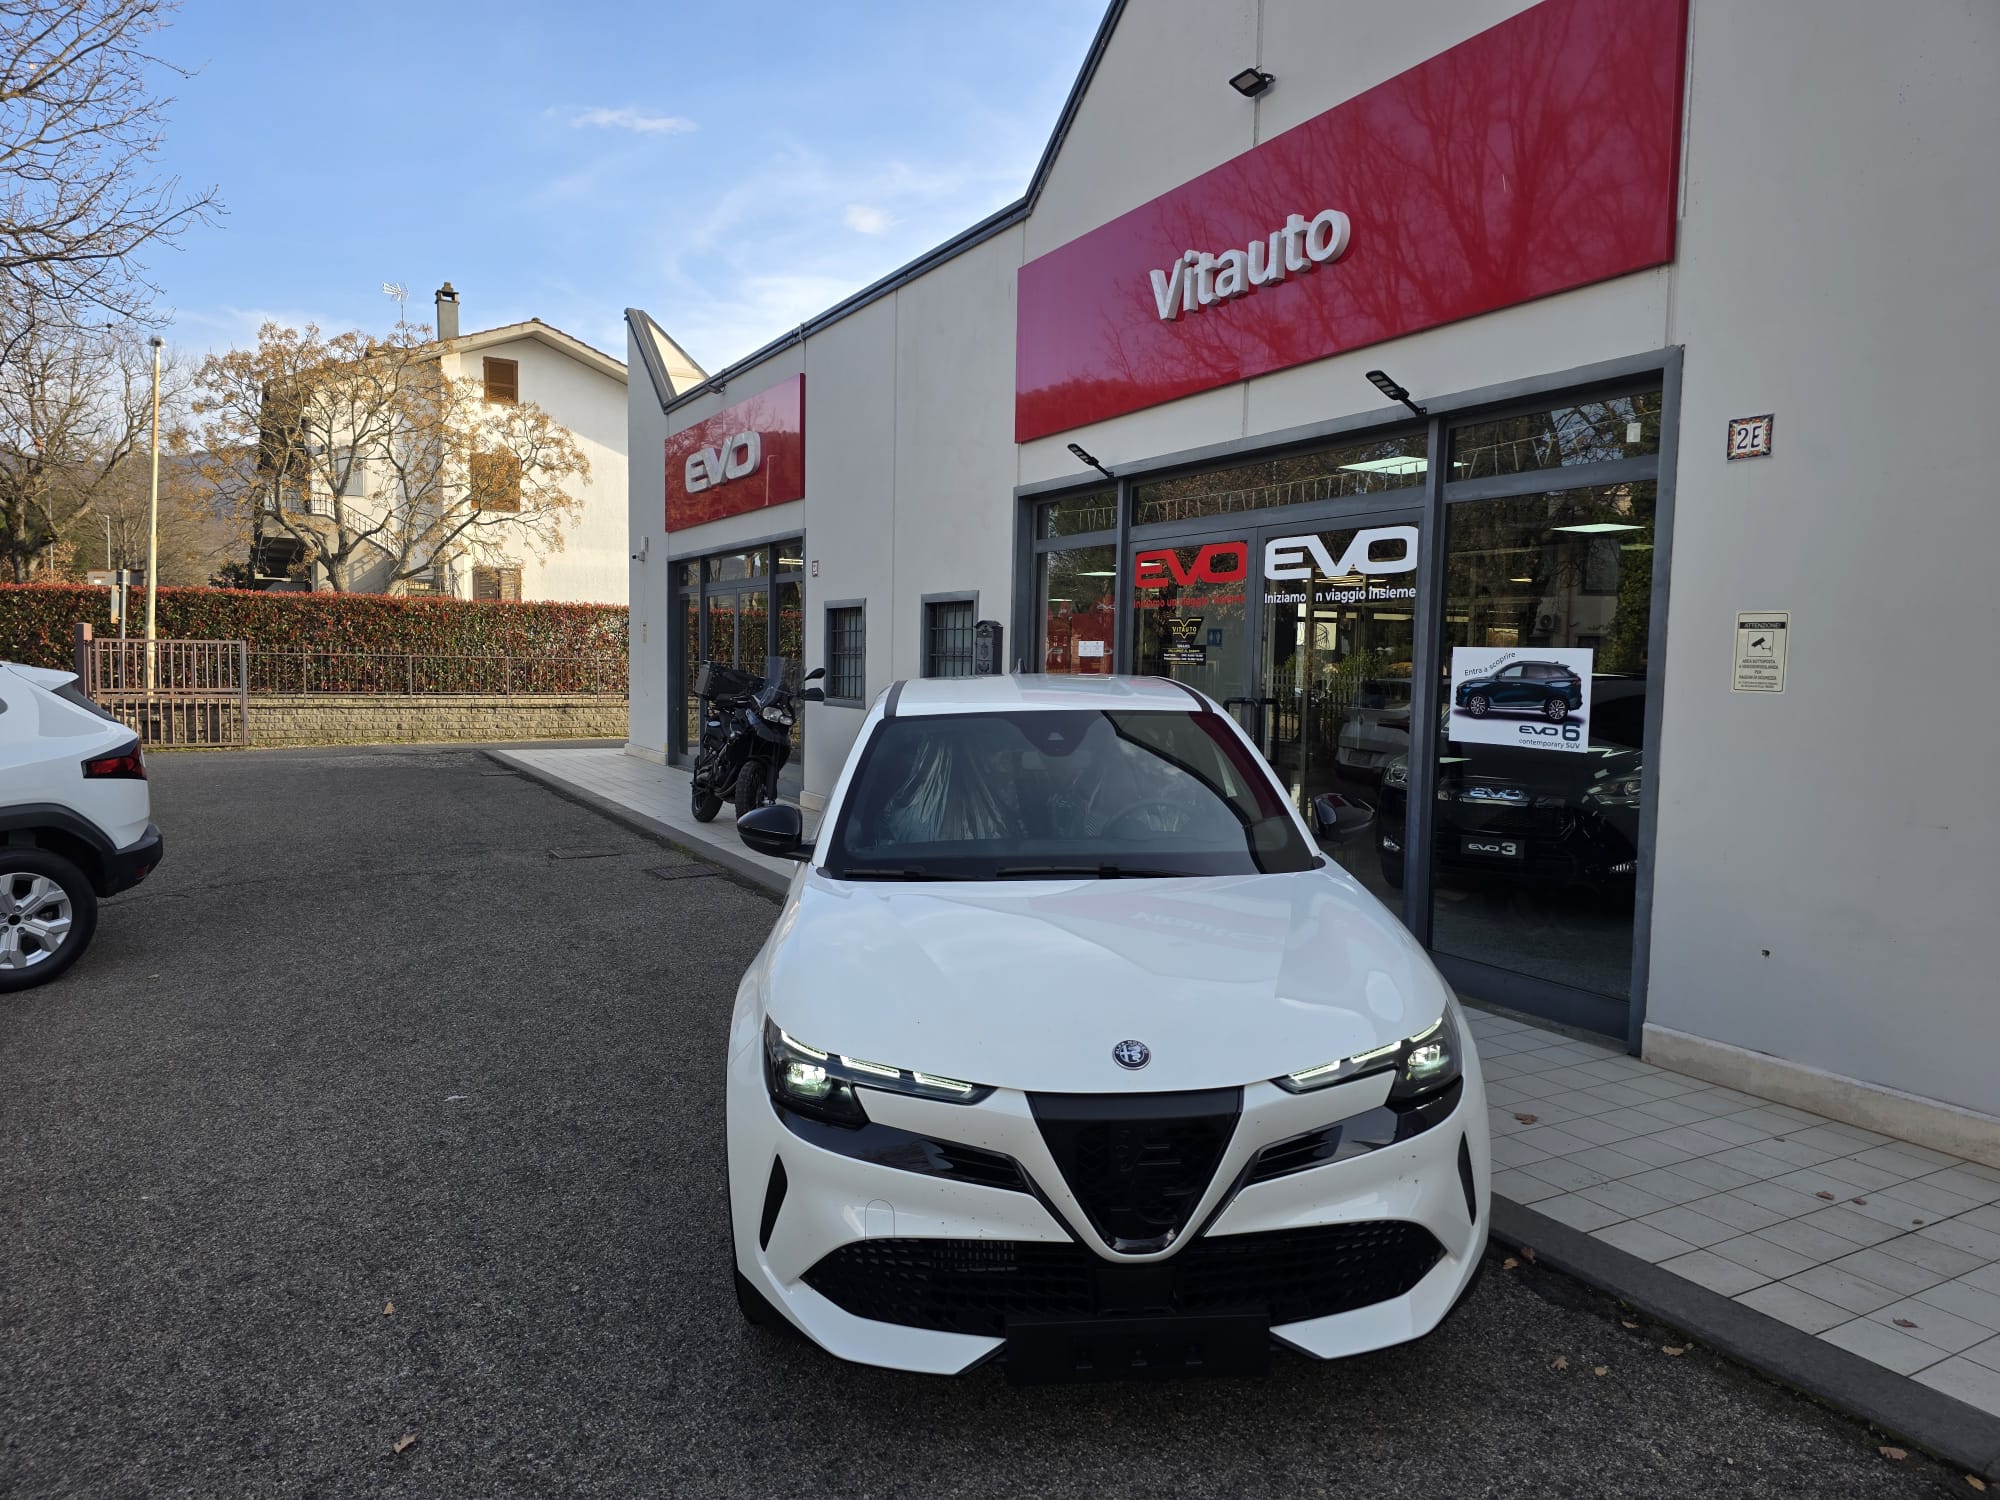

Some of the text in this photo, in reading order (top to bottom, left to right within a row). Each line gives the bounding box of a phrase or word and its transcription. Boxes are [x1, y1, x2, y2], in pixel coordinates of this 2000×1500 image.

[1150, 209, 1350, 321] Vitauto
[1737, 425, 1762, 449] 2E
[685, 431, 760, 493] EVO
[1135, 541, 1248, 588] EVO
[1265, 526, 1418, 580] EVO
[1264, 590, 1306, 603] Iniziamo
[1325, 588, 1366, 603] viaggio
[1368, 585, 1416, 599] insieme
[1464, 668, 1483, 676] Entra
[1489, 652, 1516, 670] scoprire
[1518, 739, 1564, 749] contemporary
[1519, 724, 1580, 741] EVO 6
[1468, 842, 1517, 855] EVO 3
